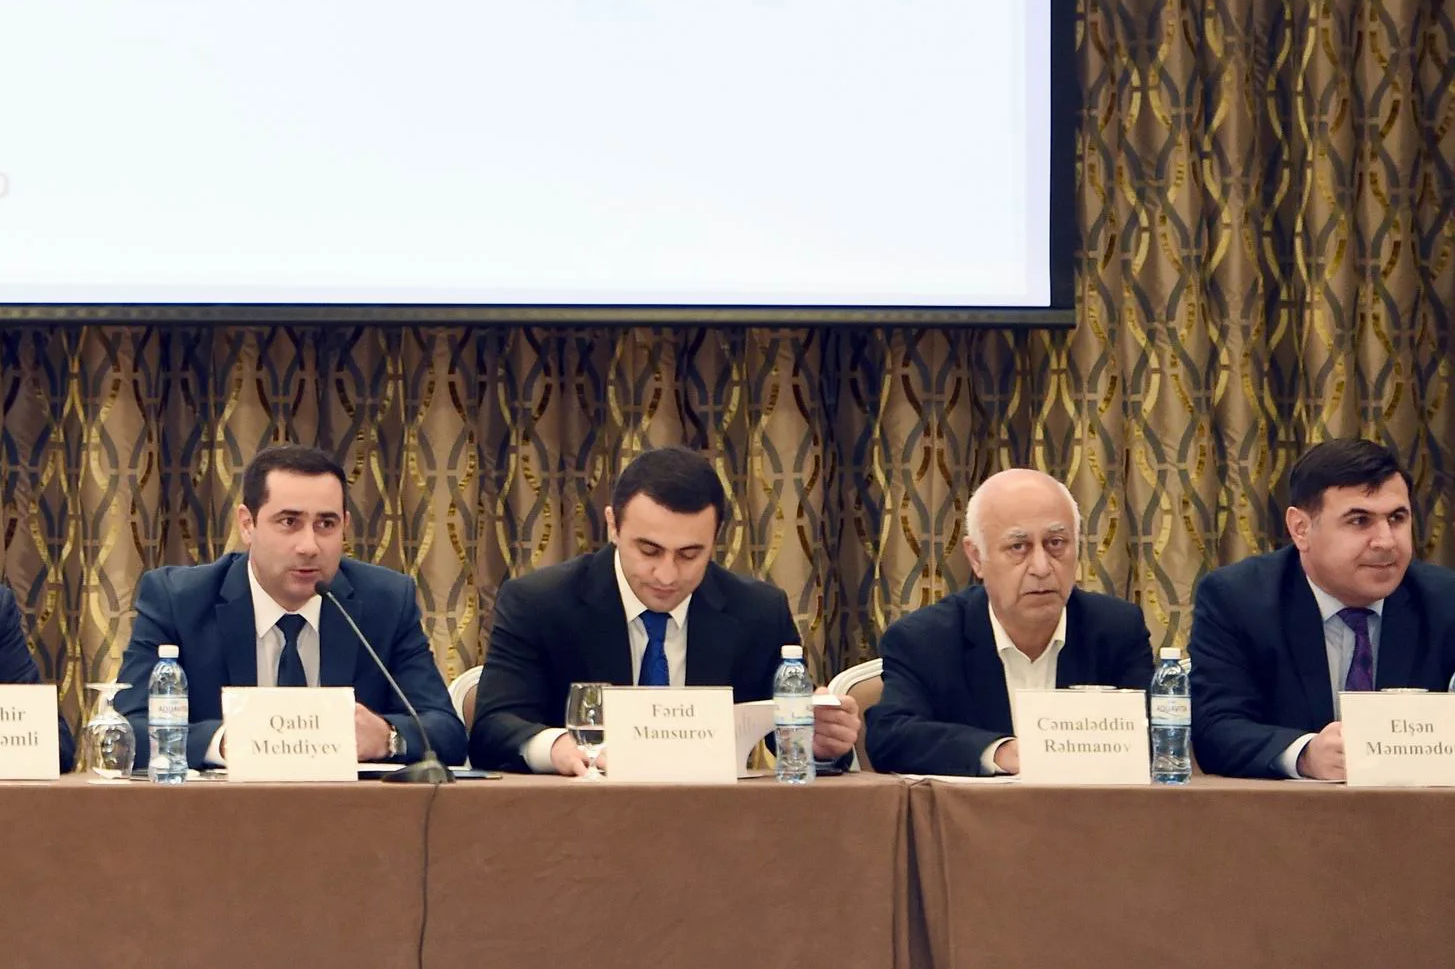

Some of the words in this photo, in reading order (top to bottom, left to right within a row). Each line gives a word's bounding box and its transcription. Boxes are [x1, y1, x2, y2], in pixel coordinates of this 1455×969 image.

[651, 704, 695, 718] Fərid
[269, 714, 321, 732] Qabil
[1036, 718, 1136, 732] Cəmaləddin
[1391, 719, 1435, 736] Elşən
[633, 726, 715, 740] Mansurov
[252, 740, 340, 758] Mehdiyev
[1044, 739, 1130, 753] Rəhmanov
[1366, 741, 1455, 756] Məmmədo
